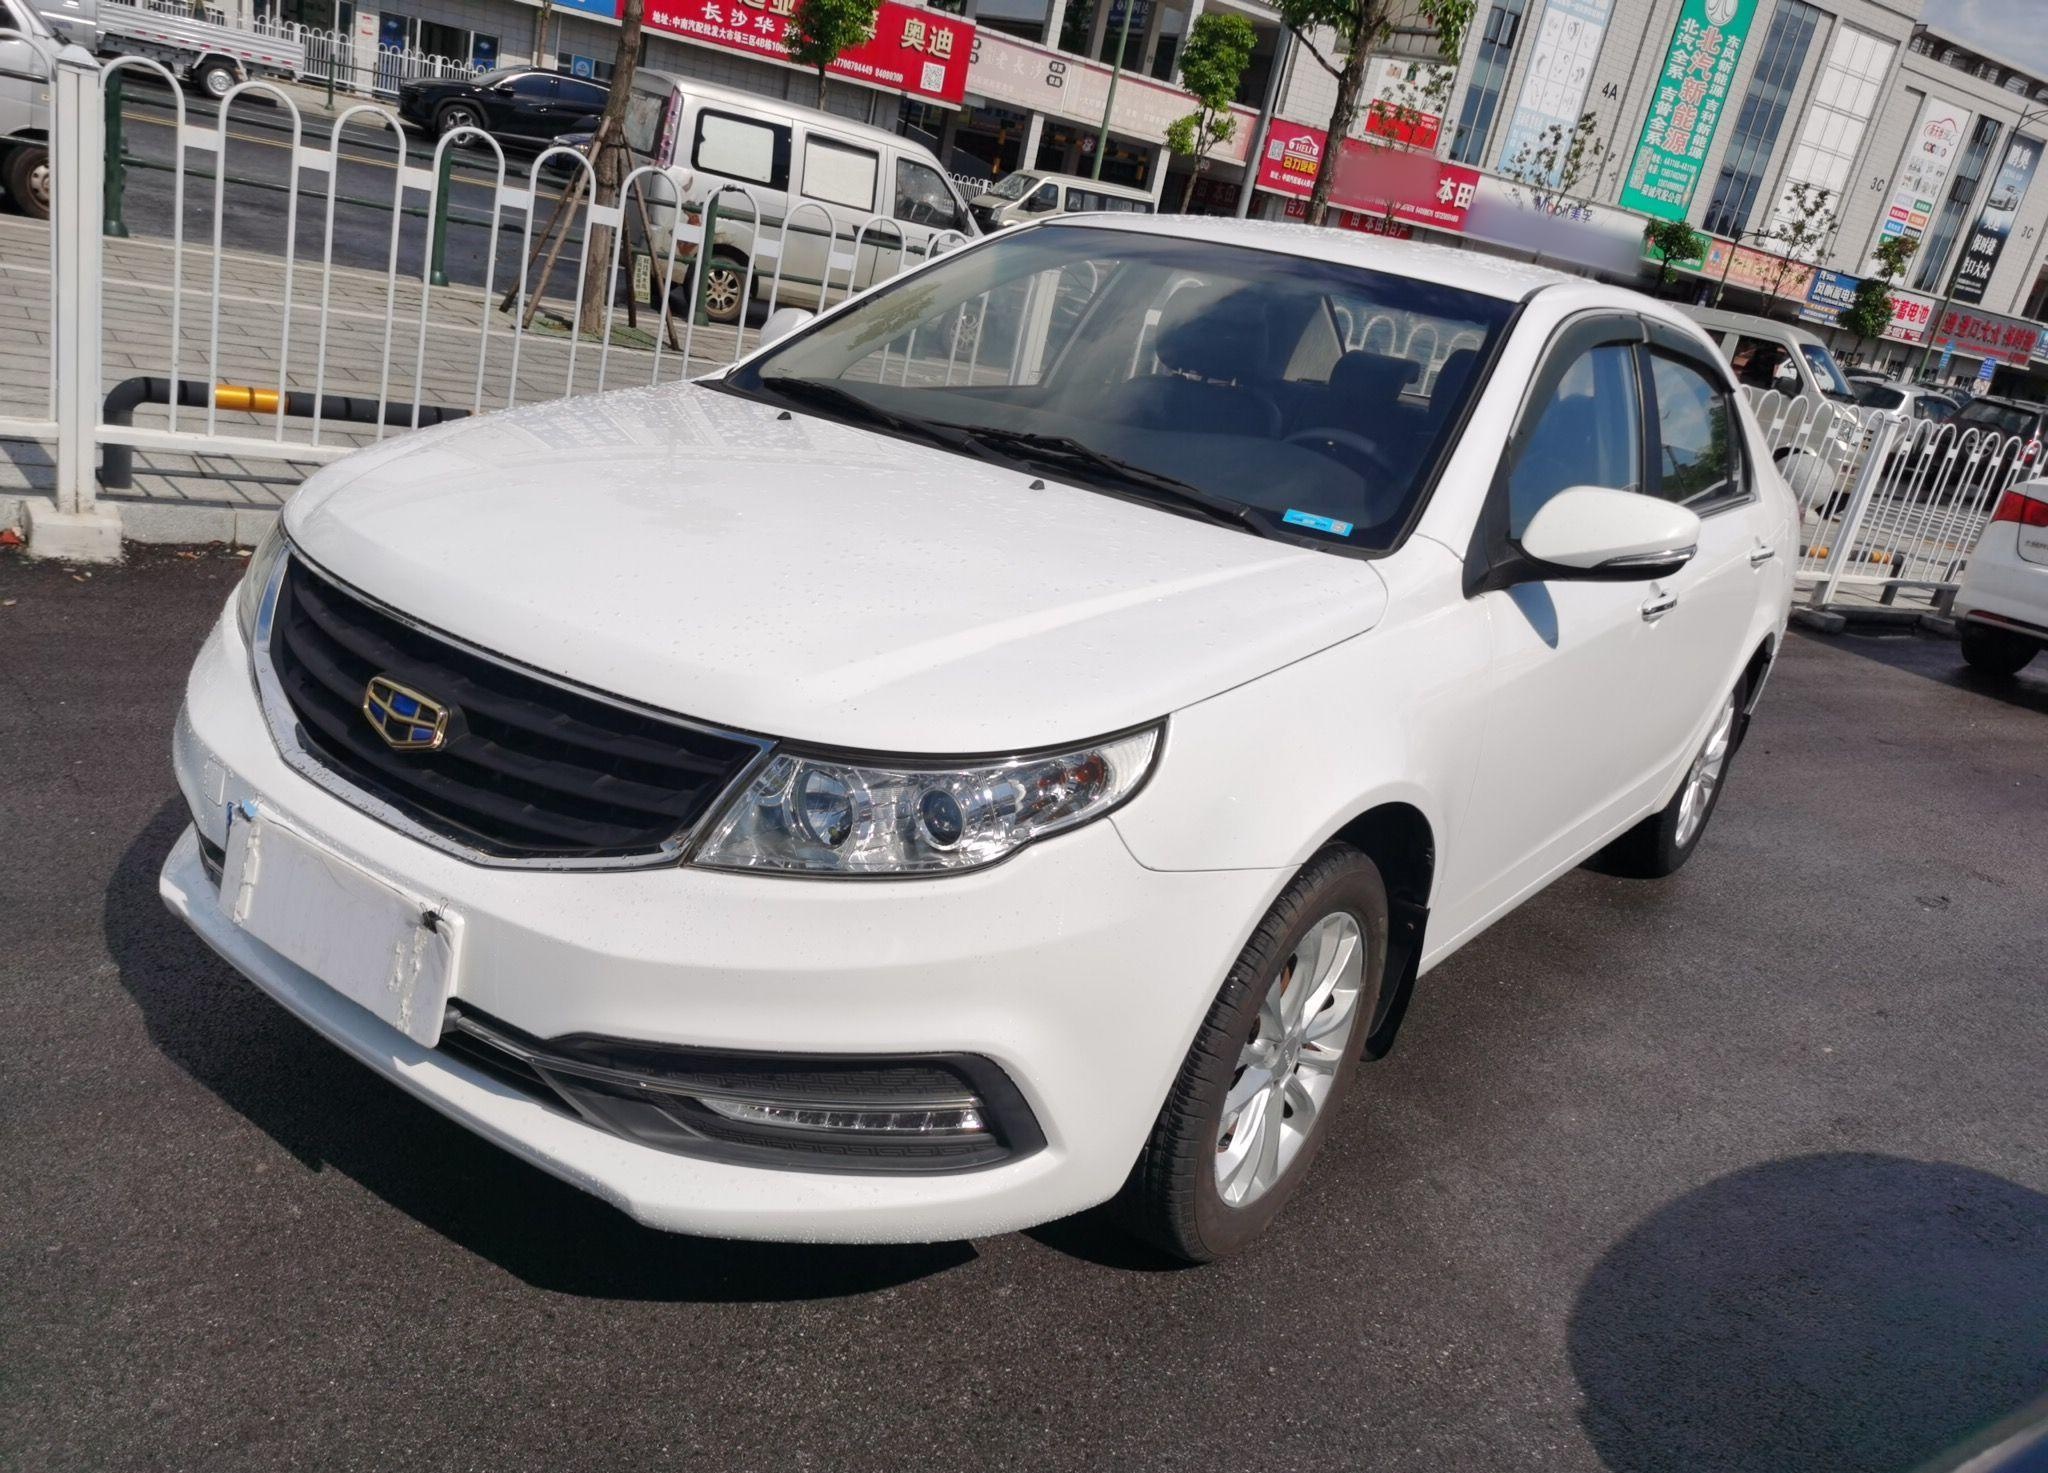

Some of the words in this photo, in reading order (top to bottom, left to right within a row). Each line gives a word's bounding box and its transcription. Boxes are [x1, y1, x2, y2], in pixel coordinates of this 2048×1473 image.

[901, 18, 954, 60] 奥迪
[1666, 18, 1699, 79] 北汽全系
[1602, 82, 1618, 101] 4A
[1661, 25, 1723, 155] 北汽新能源
[1436, 177, 1475, 210] 本田
[1870, 177, 1885, 192] 3C
